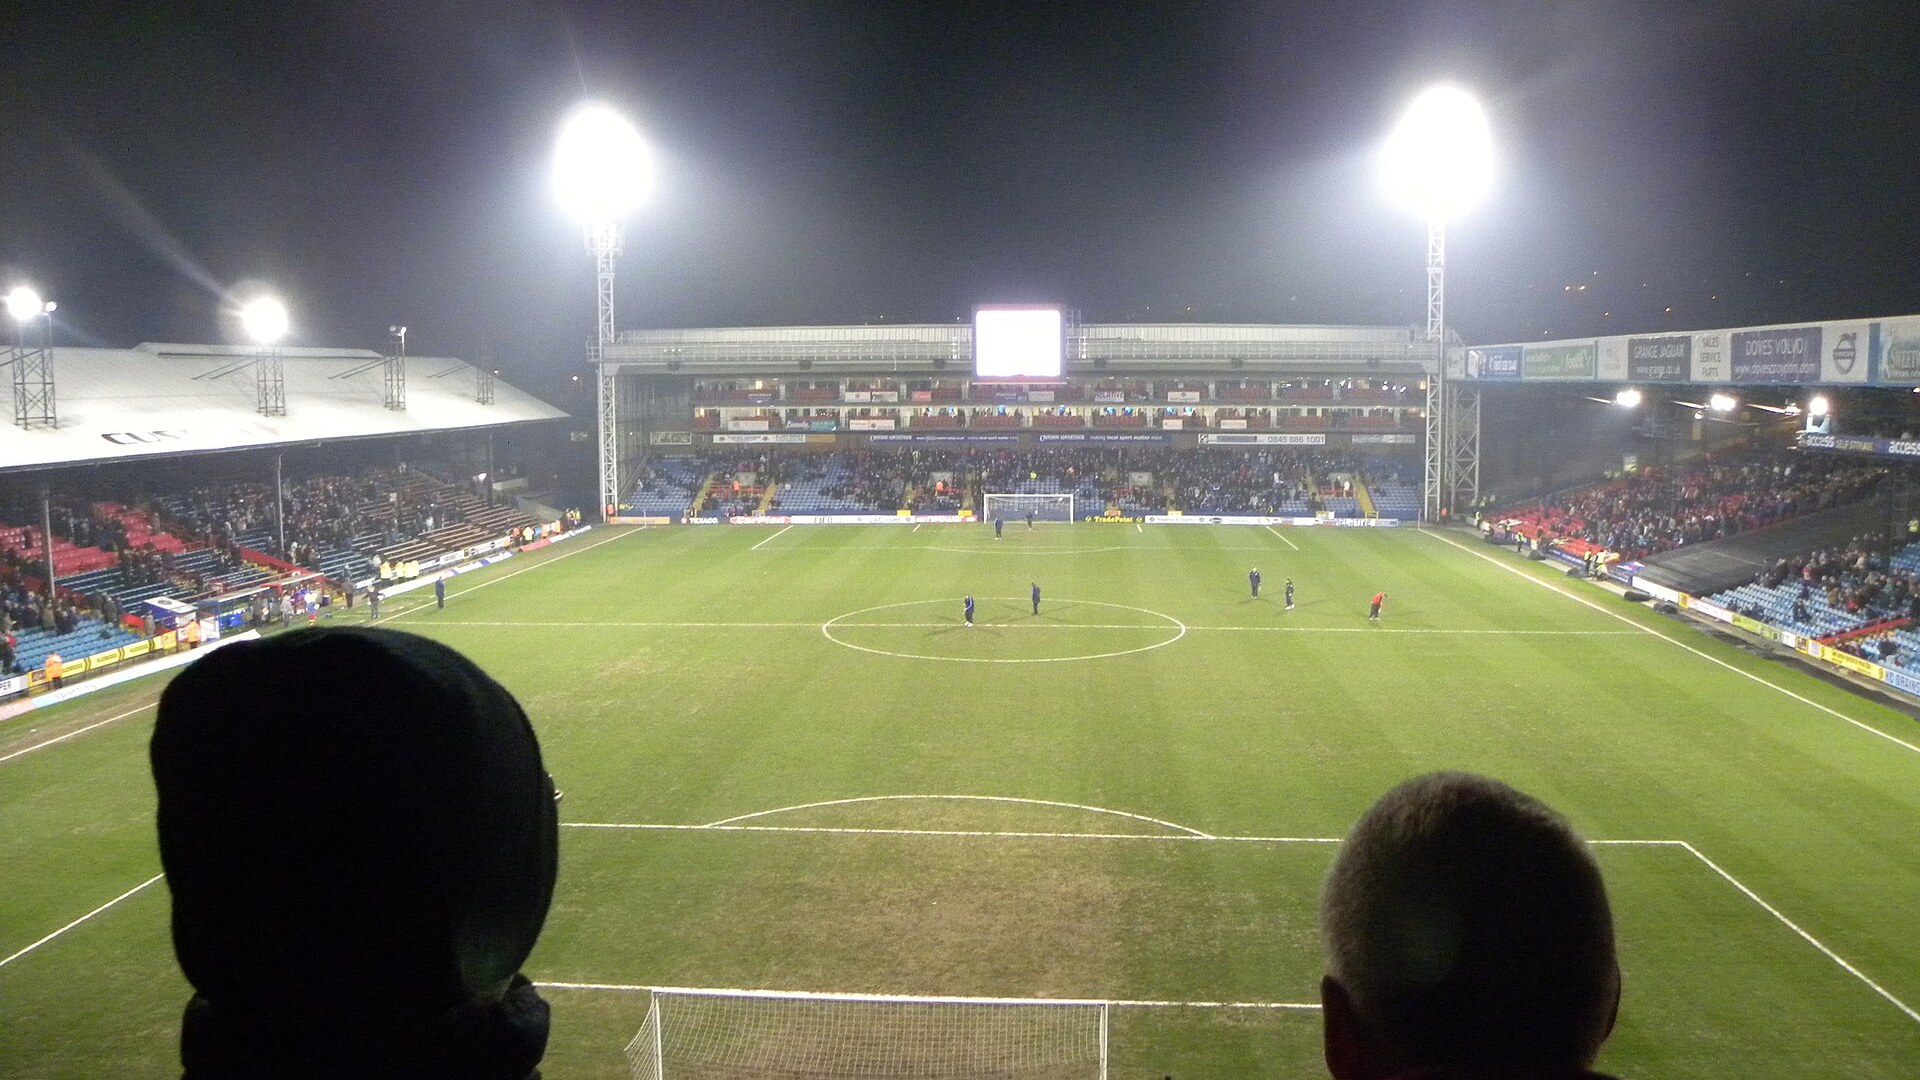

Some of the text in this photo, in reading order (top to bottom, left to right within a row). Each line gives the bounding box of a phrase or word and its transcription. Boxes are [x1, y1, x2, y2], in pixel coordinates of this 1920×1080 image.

[1702, 336, 1719, 348] SALES
[1745, 337, 1804, 356] DOVES VOLVO
[1633, 345, 1659, 359] GRANGE
[1660, 344, 1685, 358] JAGUAR
[1700, 352, 1721, 363] SERVICE
[1702, 367, 1719, 377] PARTS
[1807, 436, 1835, 448] access
